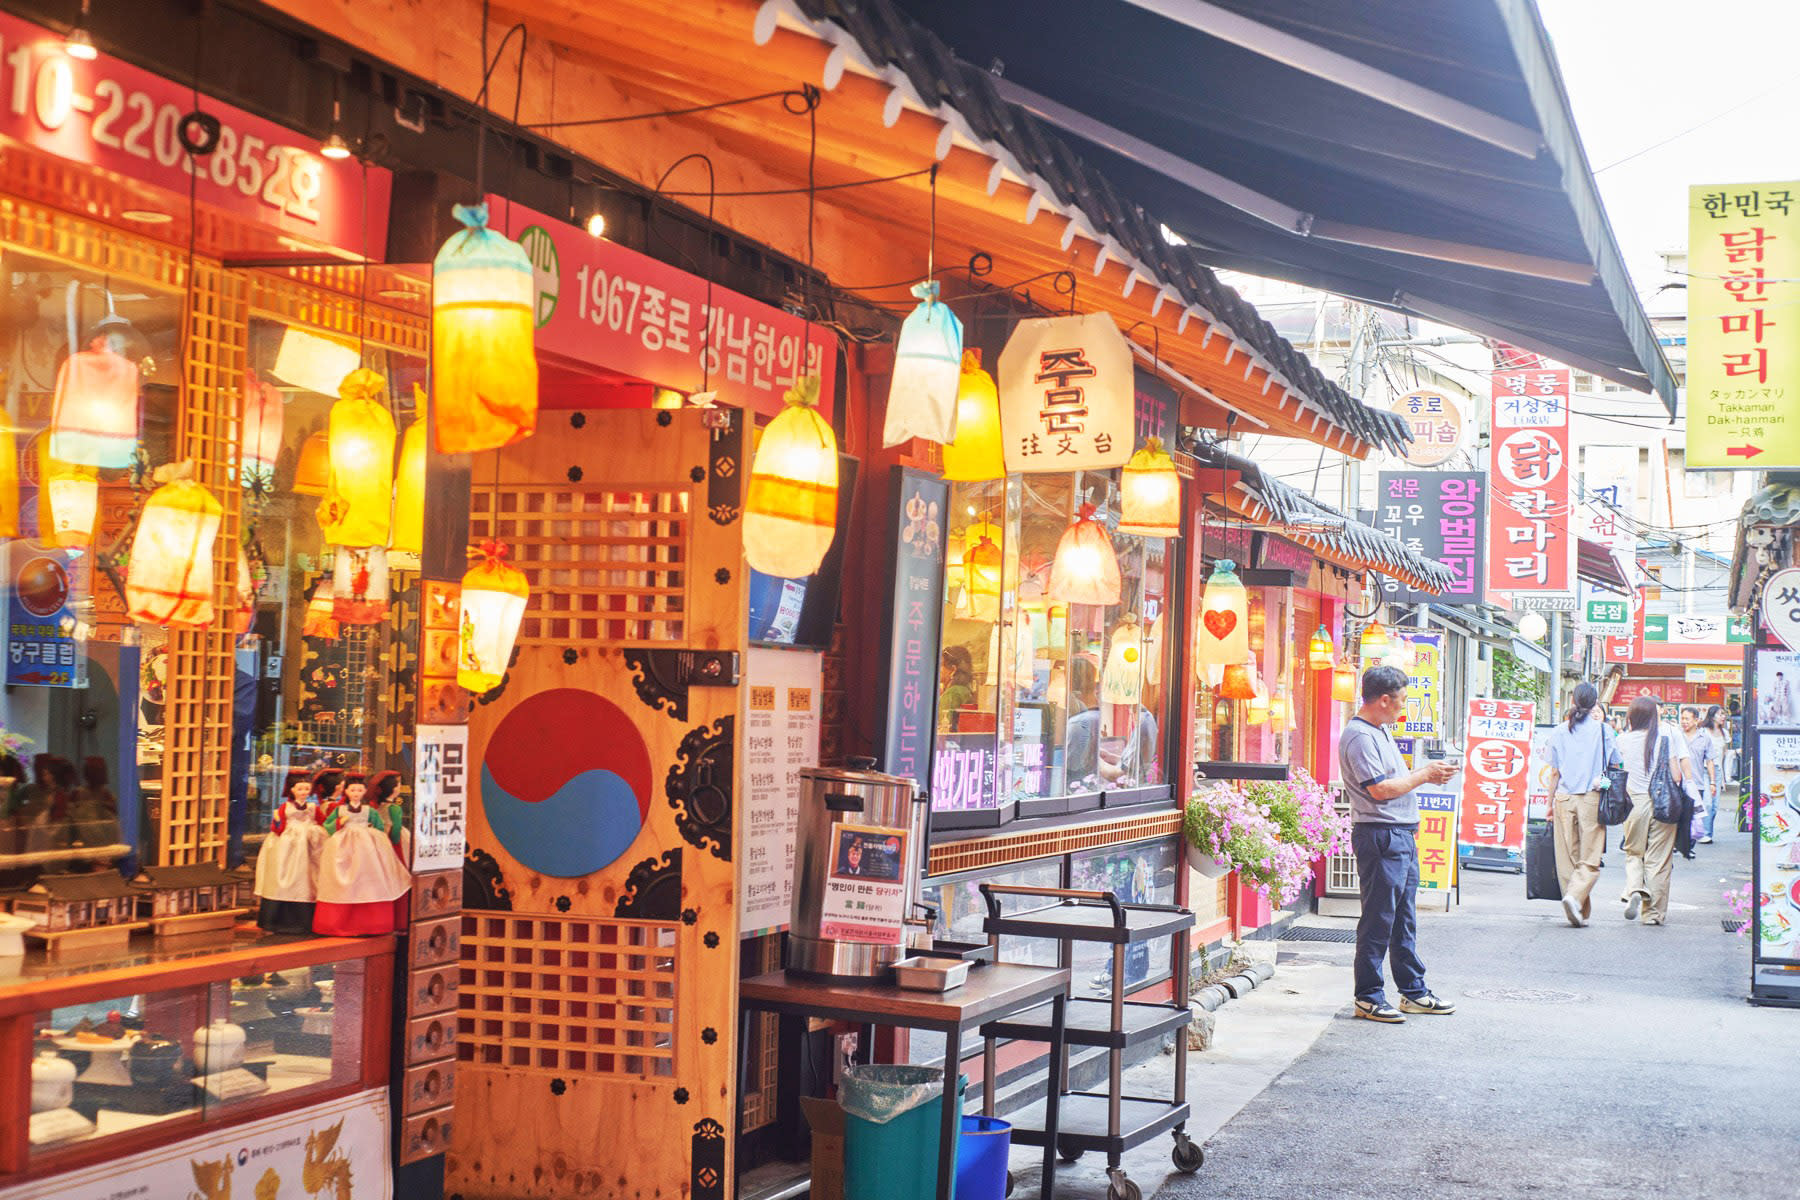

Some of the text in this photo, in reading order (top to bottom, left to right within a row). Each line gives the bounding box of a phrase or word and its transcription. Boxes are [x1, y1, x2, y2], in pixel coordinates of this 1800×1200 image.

[0, 32, 322, 223] 10-2202852호
[1702, 190, 1794, 218] 한민국
[576, 264, 691, 352] 1967종로
[1718, 227, 1777, 383] 닭한마리
[1035, 348, 1096, 435] 주문
[1504, 374, 1561, 395] 명동
[1710, 388, 1784, 400] タッカンマリ
[1407, 396, 1443, 413] 종로
[1504, 398, 1559, 413] 거성점
[1406, 420, 1457, 442] 피숍
[1707, 415, 1785, 424] Dak-hanmari
[1021, 432, 1112, 457] 注文台
[1387, 478, 1421, 498] 전문
[1503, 435, 1560, 585] 닭한마리
[1439, 479, 1481, 593] 왕벌집
[1592, 603, 1622, 620] 본점
[10, 642, 73, 665] 당구클럽
[50, 672, 69, 684] 2F
[1479, 702, 1526, 719] 명동
[1405, 722, 1434, 733] BEER
[1473, 745, 1523, 843] 닭한마리
[1417, 817, 1446, 841] 피
[1418, 849, 1446, 873] 주
